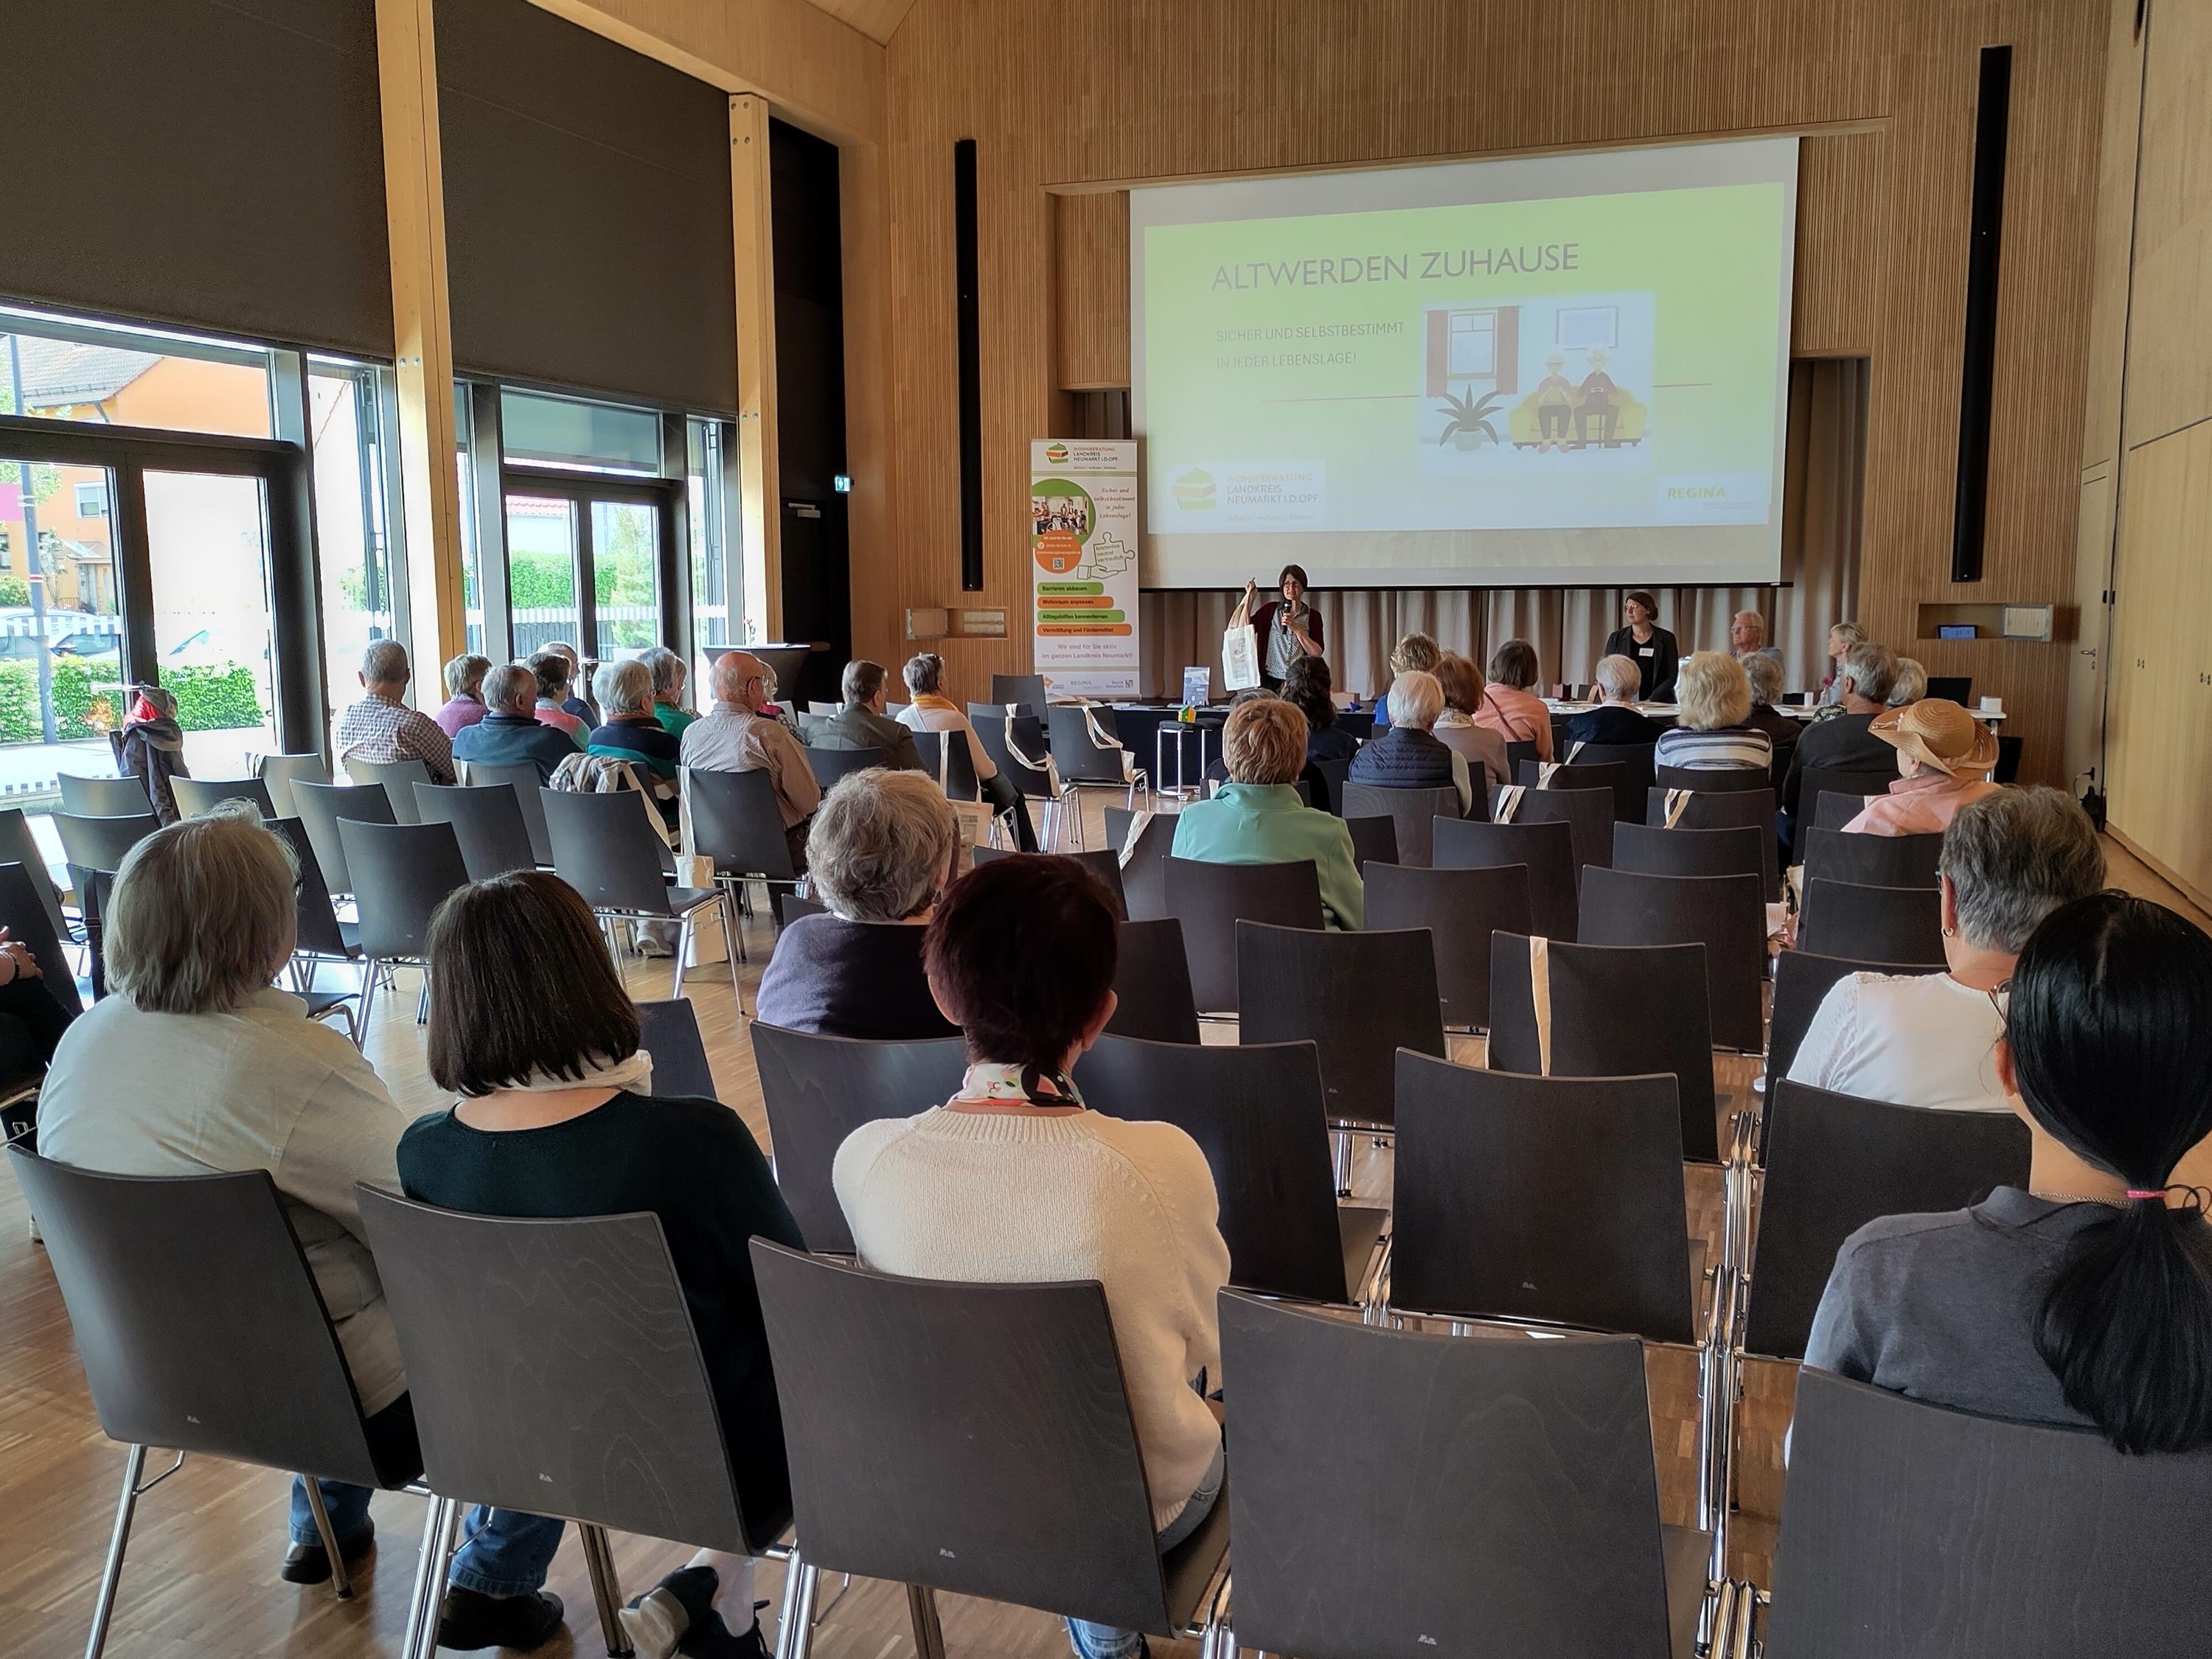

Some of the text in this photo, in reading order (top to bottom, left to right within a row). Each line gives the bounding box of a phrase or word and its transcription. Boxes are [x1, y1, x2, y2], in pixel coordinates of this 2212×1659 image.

[1211, 243, 1579, 291] ALTWERDEN ZUHAUSE
[1216, 321, 1405, 342] SICHER UND SELBSTBESTIMMT
[1217, 352, 1357, 369] IN JEDER LEBENSLAGE!
[1227, 473, 1312, 484] WOHNBERATUNG
[1227, 484, 1282, 494] LANDKREIS
[1668, 487, 1727, 499] REGINA
[1227, 494, 1321, 504] NEUMARKT I.D.OPF.
